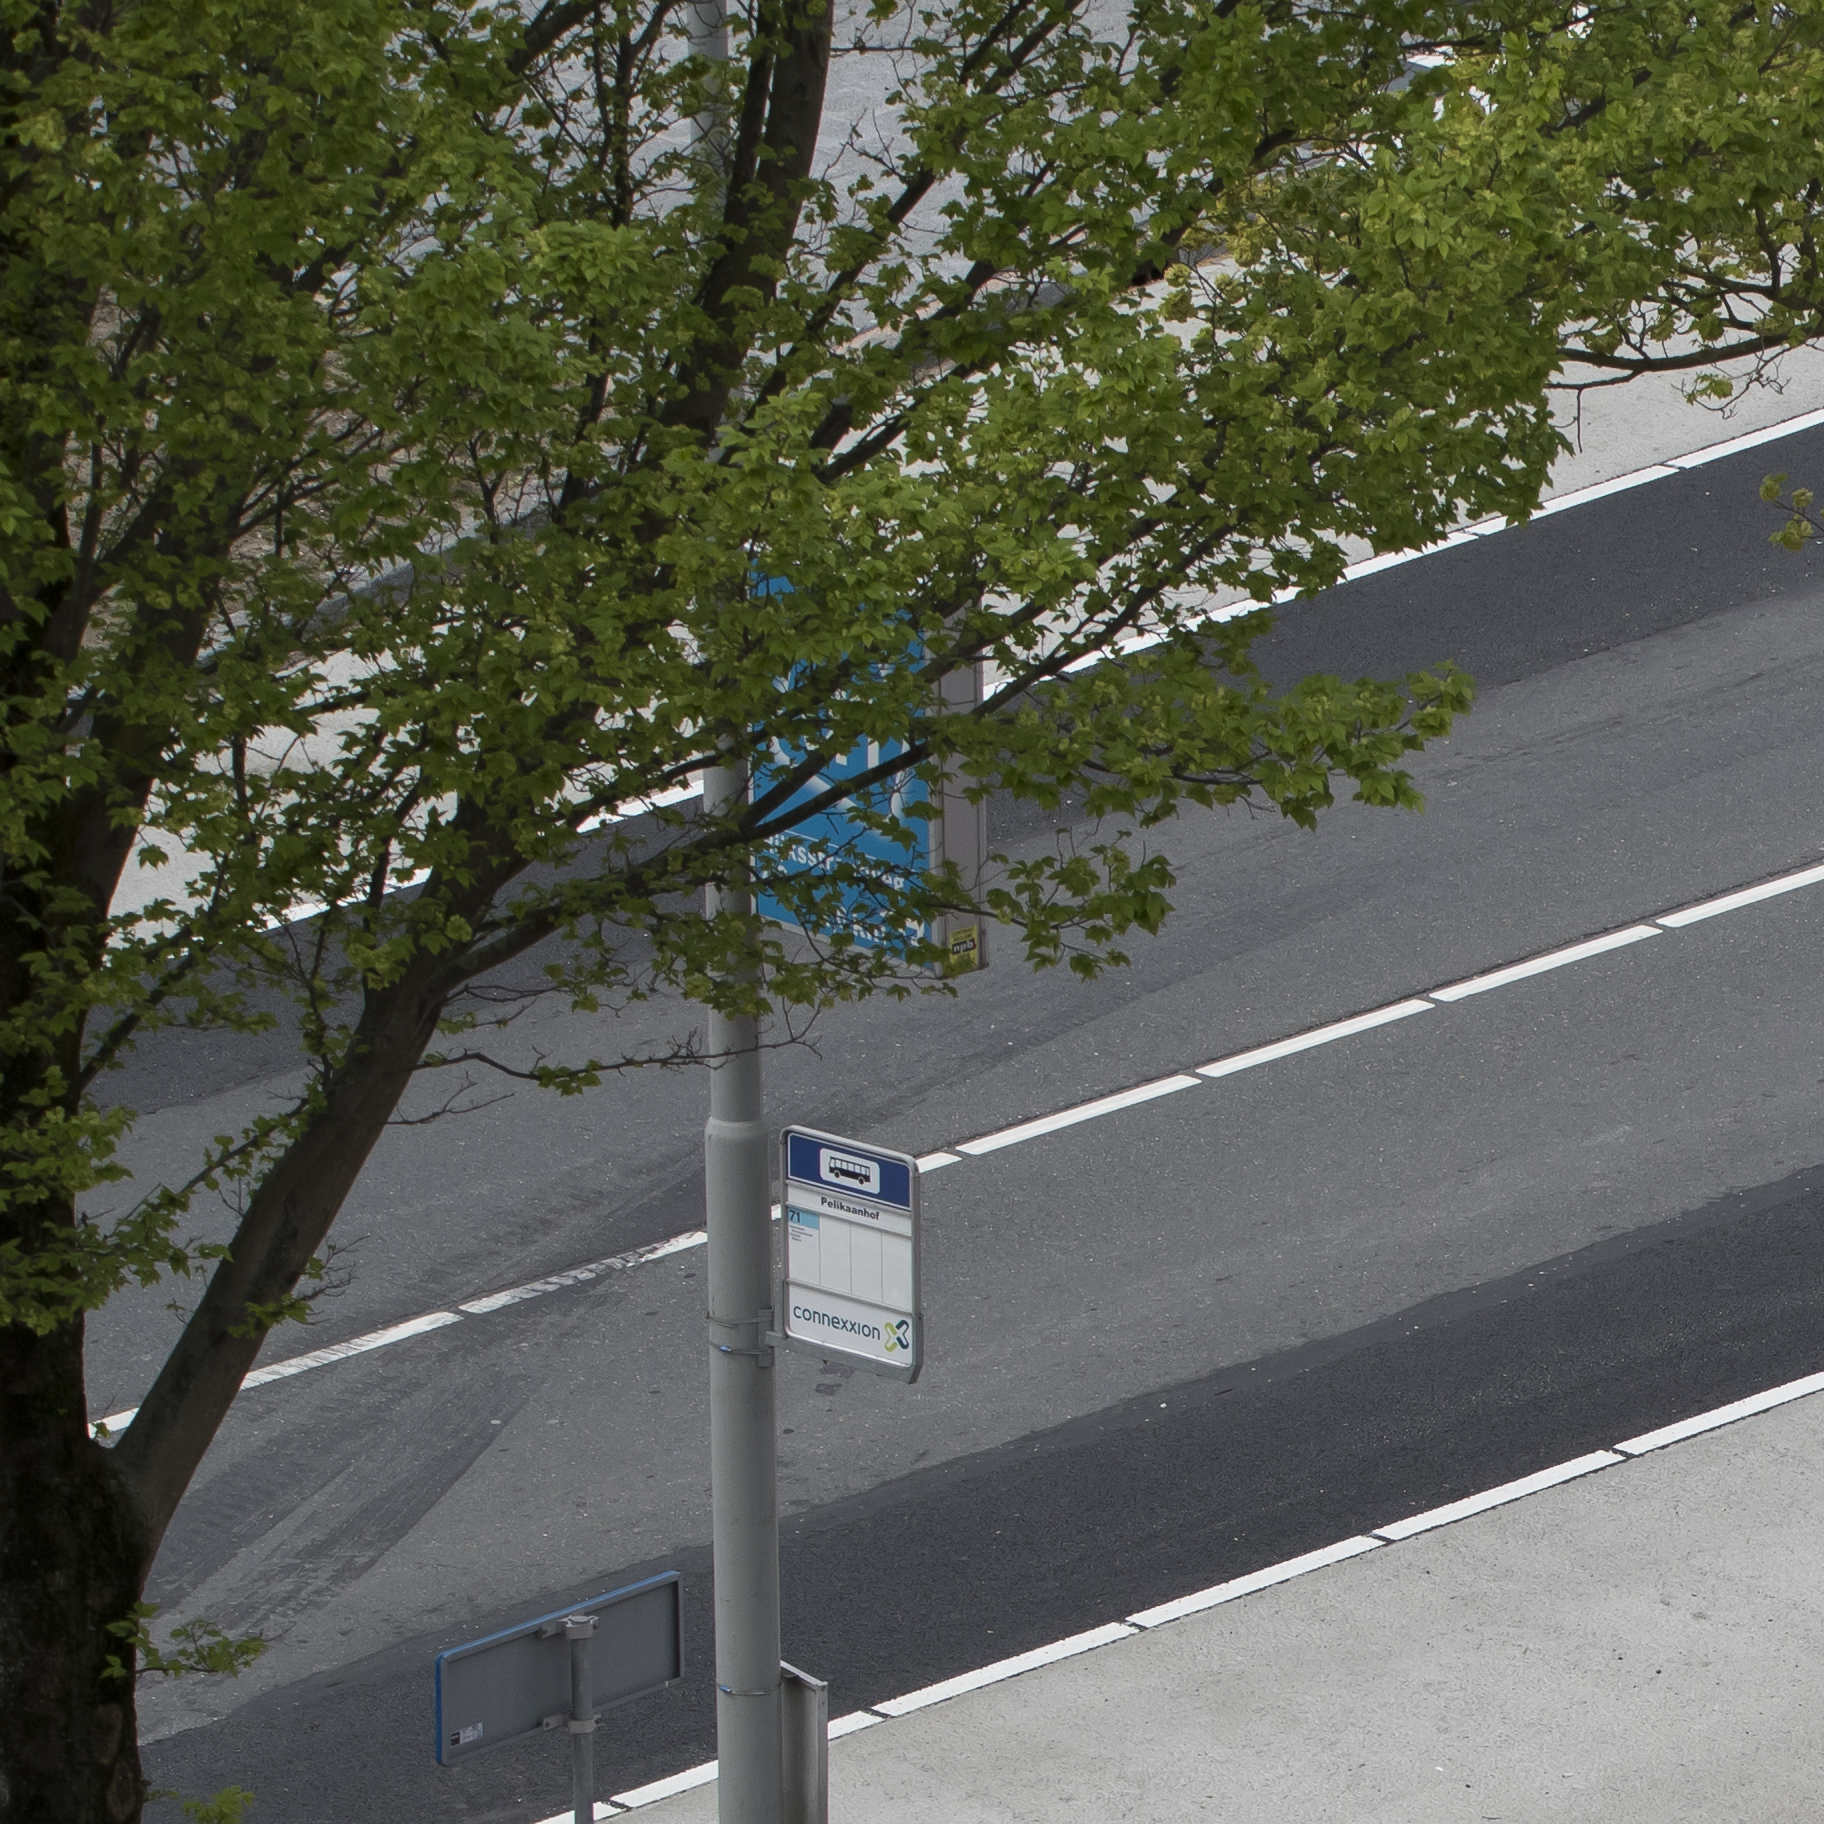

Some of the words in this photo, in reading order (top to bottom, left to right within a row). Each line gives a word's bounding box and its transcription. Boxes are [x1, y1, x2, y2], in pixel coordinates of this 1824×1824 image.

[789, 1210, 800, 1223] 71
[821, 1196, 880, 1220] Pelikaanhof
[793, 1306, 881, 1341] connexxion
